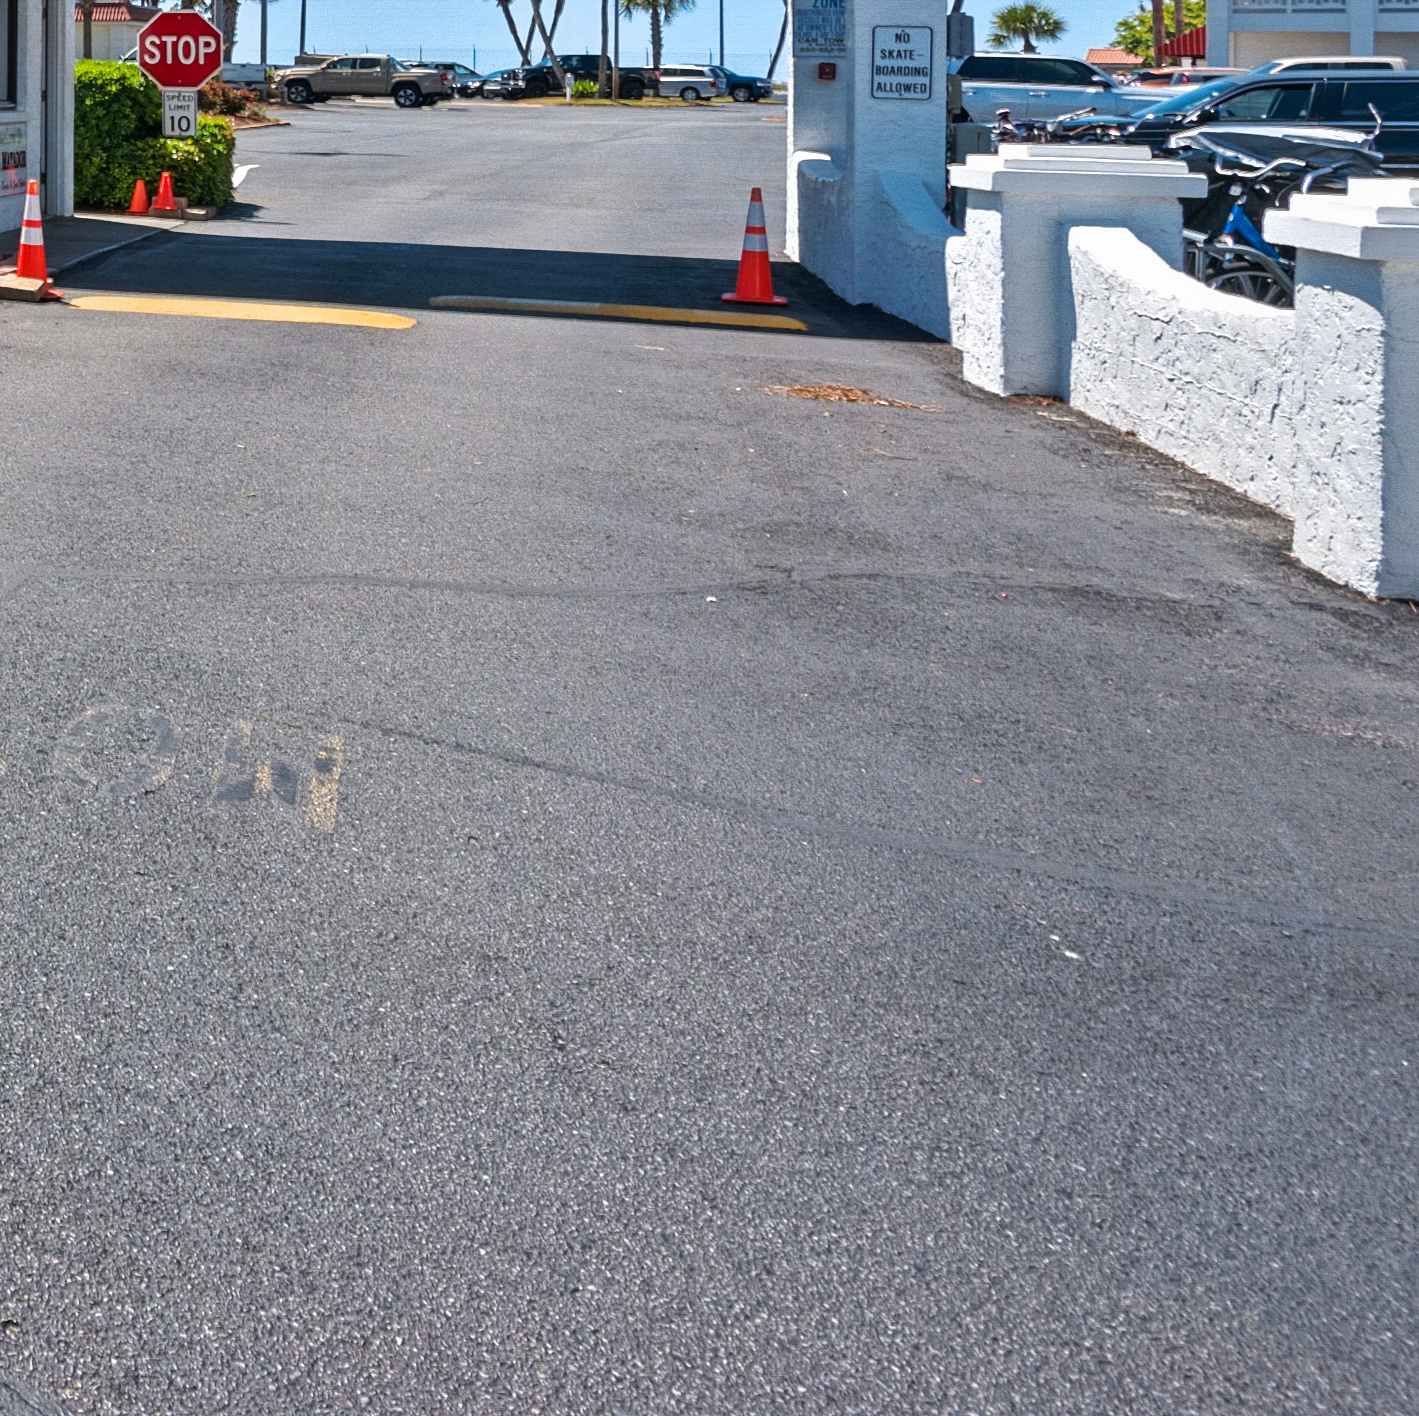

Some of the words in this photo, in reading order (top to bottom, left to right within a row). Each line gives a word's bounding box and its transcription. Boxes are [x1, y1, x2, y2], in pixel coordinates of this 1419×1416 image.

[894, 32, 910, 43] NO
[144, 35, 216, 64] STOP
[880, 49, 925, 60] SKATE-
[875, 65, 929, 77] BOARDING
[876, 81, 927, 94] ALLOWED
[169, 115, 191, 133] 10
